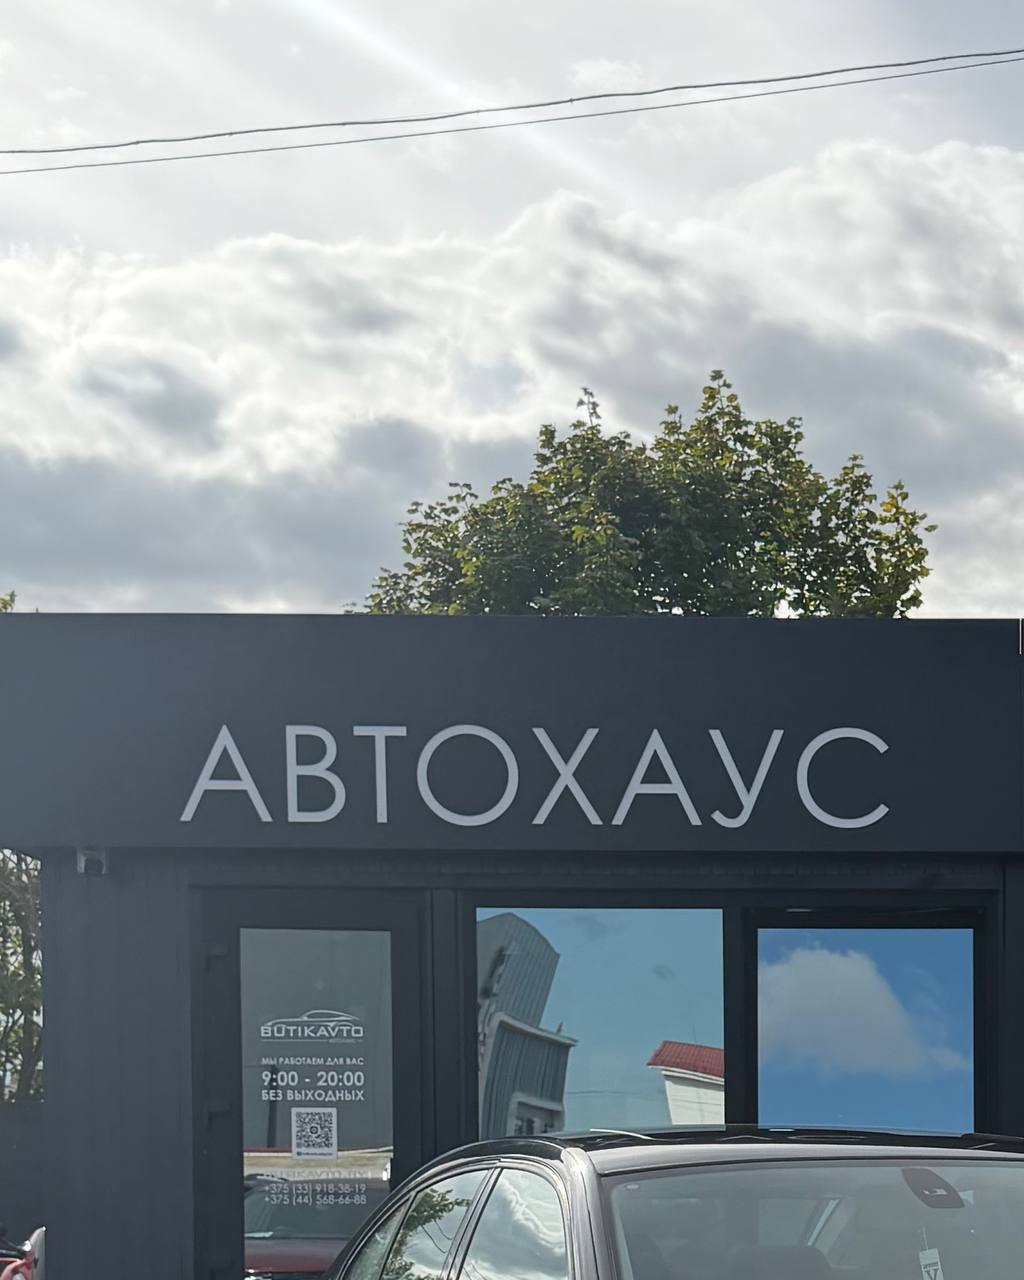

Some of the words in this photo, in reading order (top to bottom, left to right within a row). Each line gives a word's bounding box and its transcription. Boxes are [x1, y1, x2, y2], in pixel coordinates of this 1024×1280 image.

[181, 725, 891, 829] АВТОХАУС
[260, 1025, 364, 1037] BUTIKAVTO
[261, 1057, 277, 1065] МЫ
[279, 1057, 324, 1065] РАБОТАЕМ
[325, 1057, 344, 1066] ДЛЯ
[345, 1057, 364, 1065] ВАС
[262, 1071, 298, 1086] 9:00
[316, 1071, 365, 1086] 20:00
[261, 1090, 283, 1101] БЕЗ
[286, 1090, 365, 1102] ВЫХОДНЫХ
[265, 1183, 289, 1194] +375
[292, 1183, 313, 1195] (33)
[314, 1183, 367, 1194] 918-38-19
[265, 1194, 289, 1205] +375
[292, 1194, 313, 1206] (44)
[315, 1194, 367, 1205] 568-66-88
